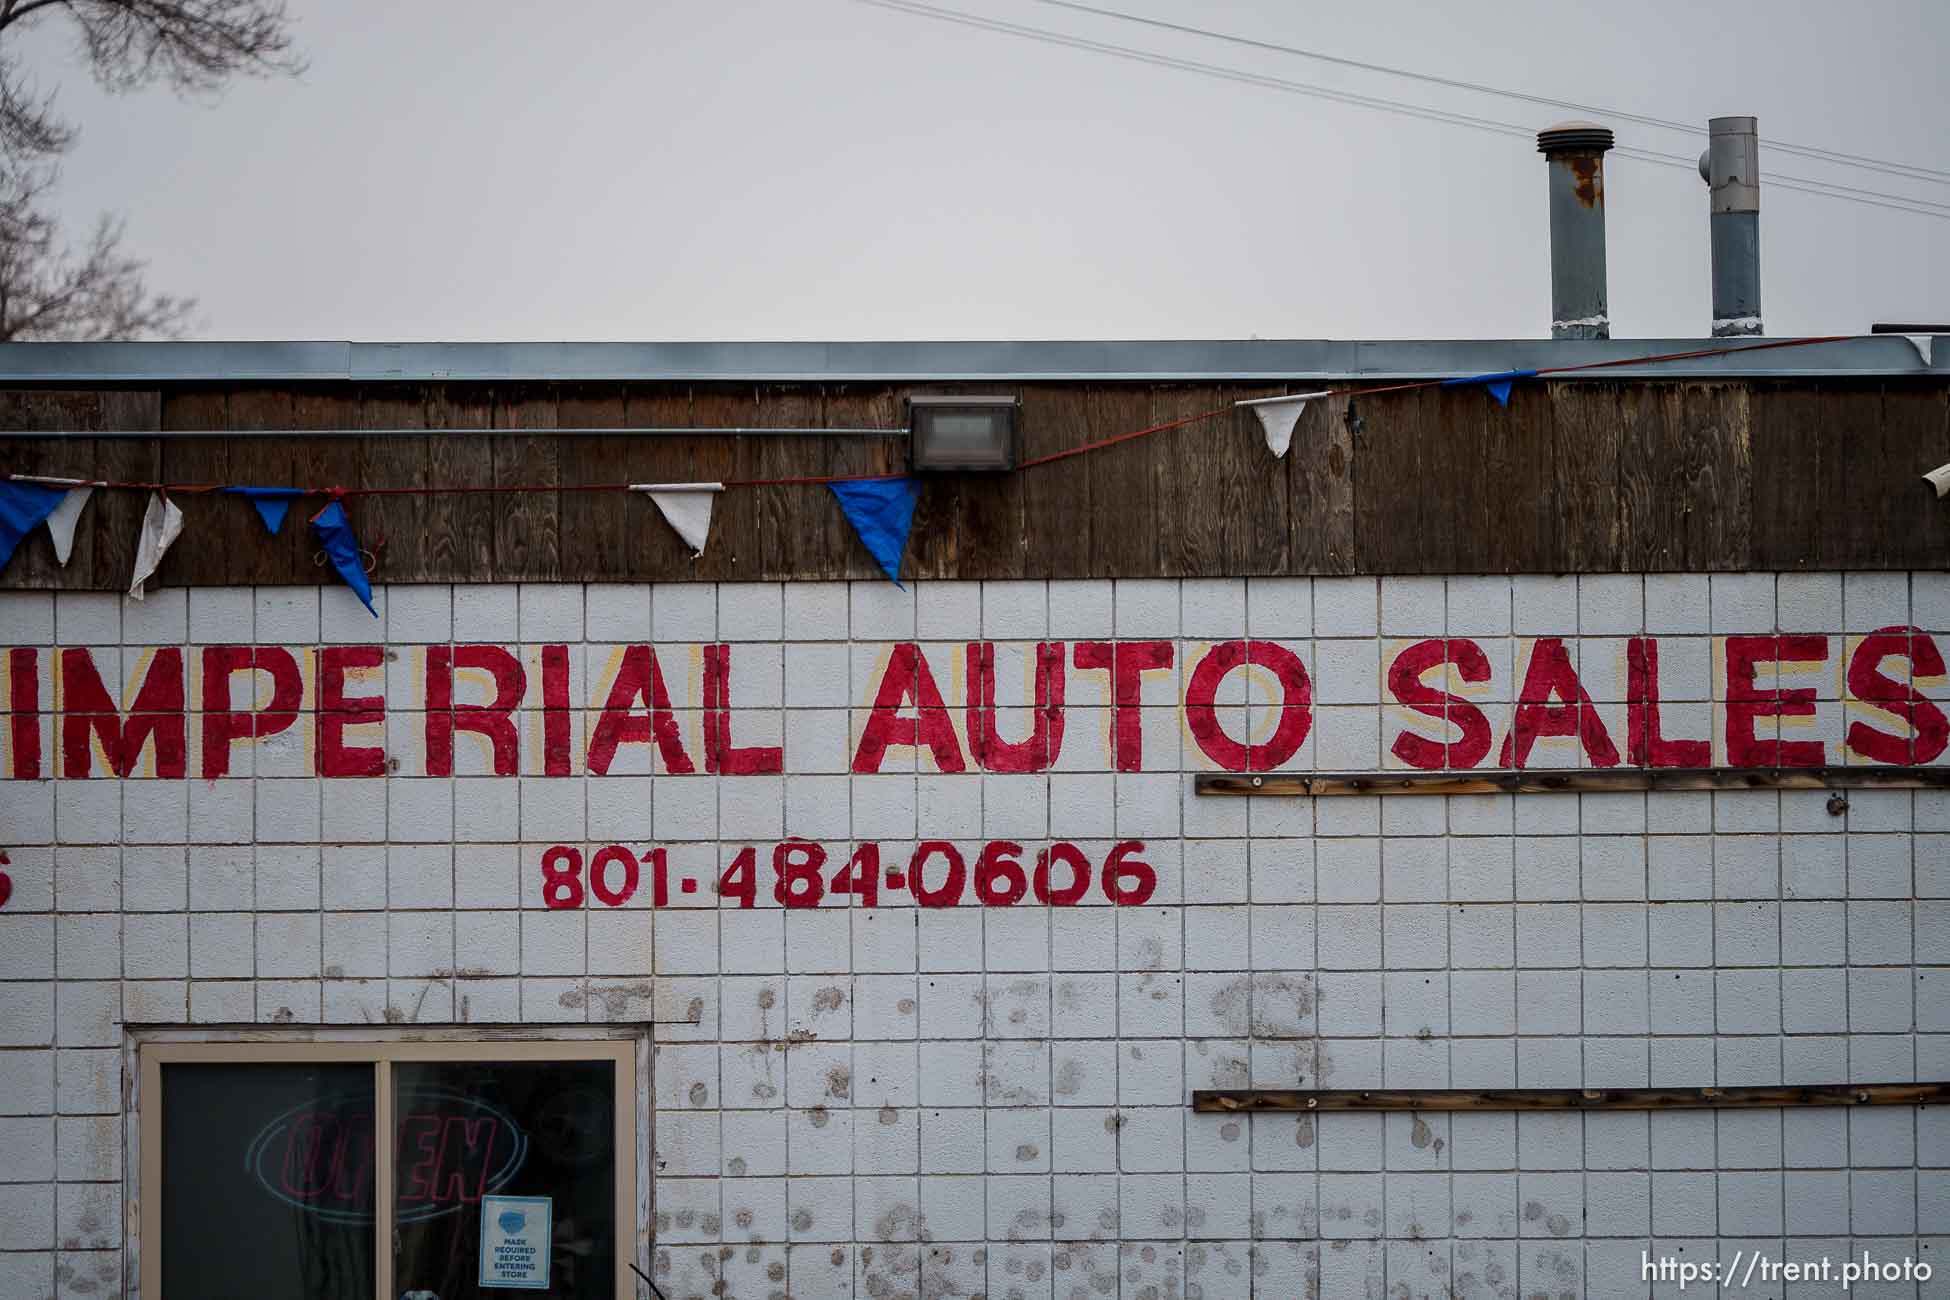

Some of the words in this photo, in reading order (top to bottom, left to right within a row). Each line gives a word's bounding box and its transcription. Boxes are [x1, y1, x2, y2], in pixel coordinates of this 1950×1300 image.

[10, 643, 784, 779] IMPERIAL
[851, 641, 1312, 773] AUTO
[1387, 625, 1950, 768] SALES
[279, 1113, 497, 1204] OPEN
[504, 1238, 527, 1246] MASK
